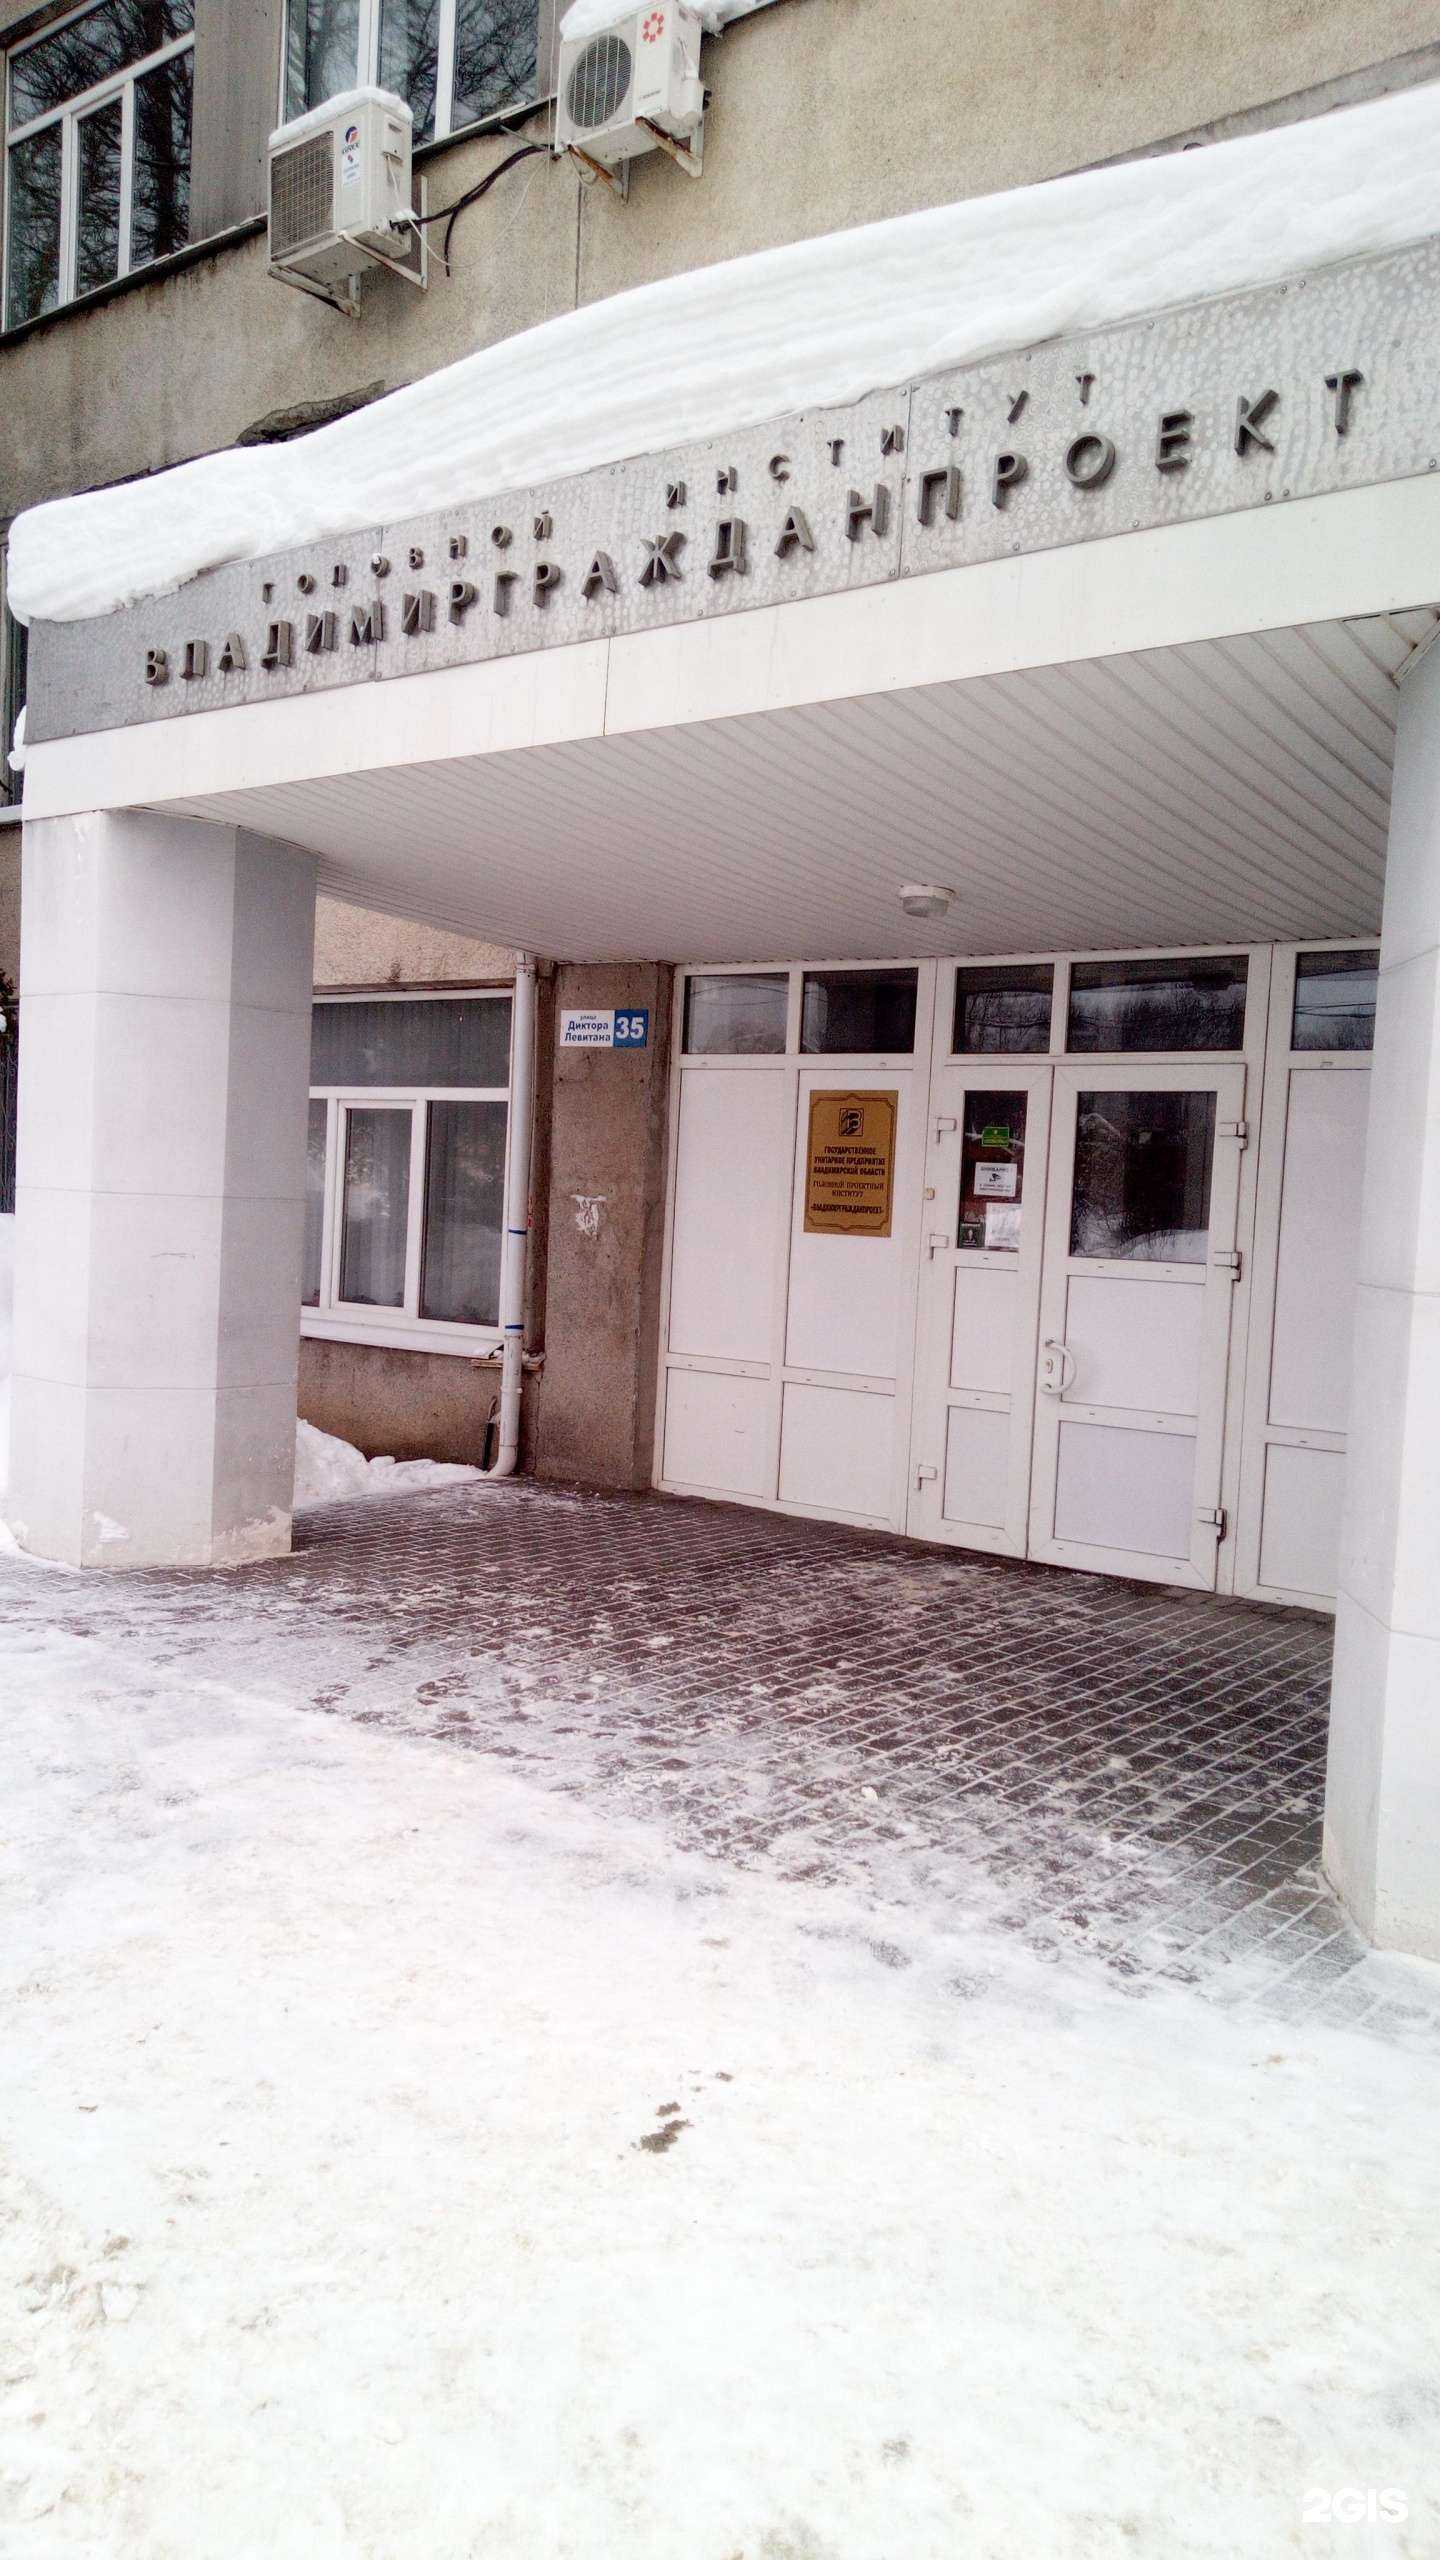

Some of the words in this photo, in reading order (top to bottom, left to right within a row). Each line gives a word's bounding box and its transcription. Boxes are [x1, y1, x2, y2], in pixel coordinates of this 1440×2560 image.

[262, 510, 554, 604] ГОЛОВНОЙ
[665, 372, 1095, 509] ИНСТИТУТ
[144, 367, 1364, 686] ВЛАДИМИРГРАЖДАНПРОЕКТ
[567, 1021, 609, 1031] Диктора
[615, 1016, 644, 1040] 35
[565, 1032, 611, 1042] Левитана
[824, 1146, 876, 1154] ГОСУДАРСТВЕННОЕ
[814, 1156, 845, 1164] УНИТАРНОЕ
[846, 1157, 885, 1165] ПРЕДПРИЯТИЕ
